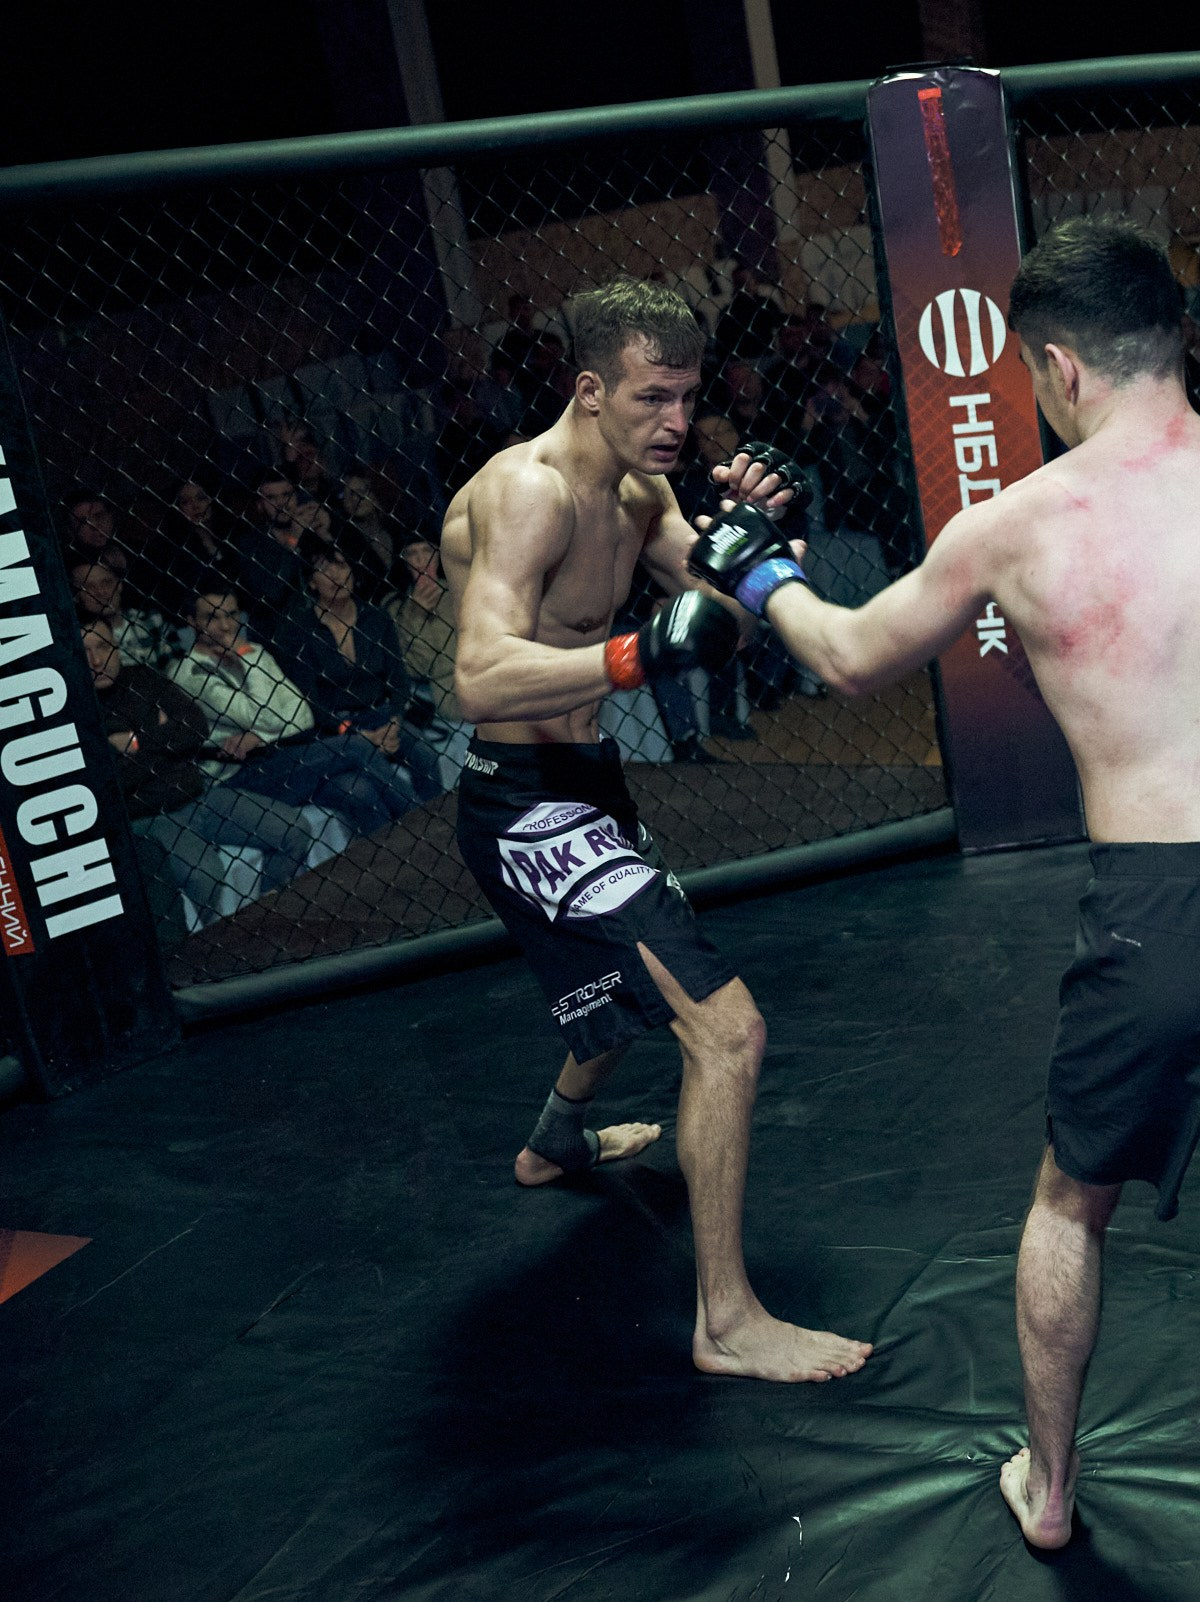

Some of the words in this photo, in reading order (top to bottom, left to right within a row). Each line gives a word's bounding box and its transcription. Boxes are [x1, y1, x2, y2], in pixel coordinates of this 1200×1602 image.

[523, 804, 593, 831] PROFESSION
[592, 881, 606, 894] OF
[608, 867, 650, 884] QUALITY
[559, 993, 613, 1025] Management
